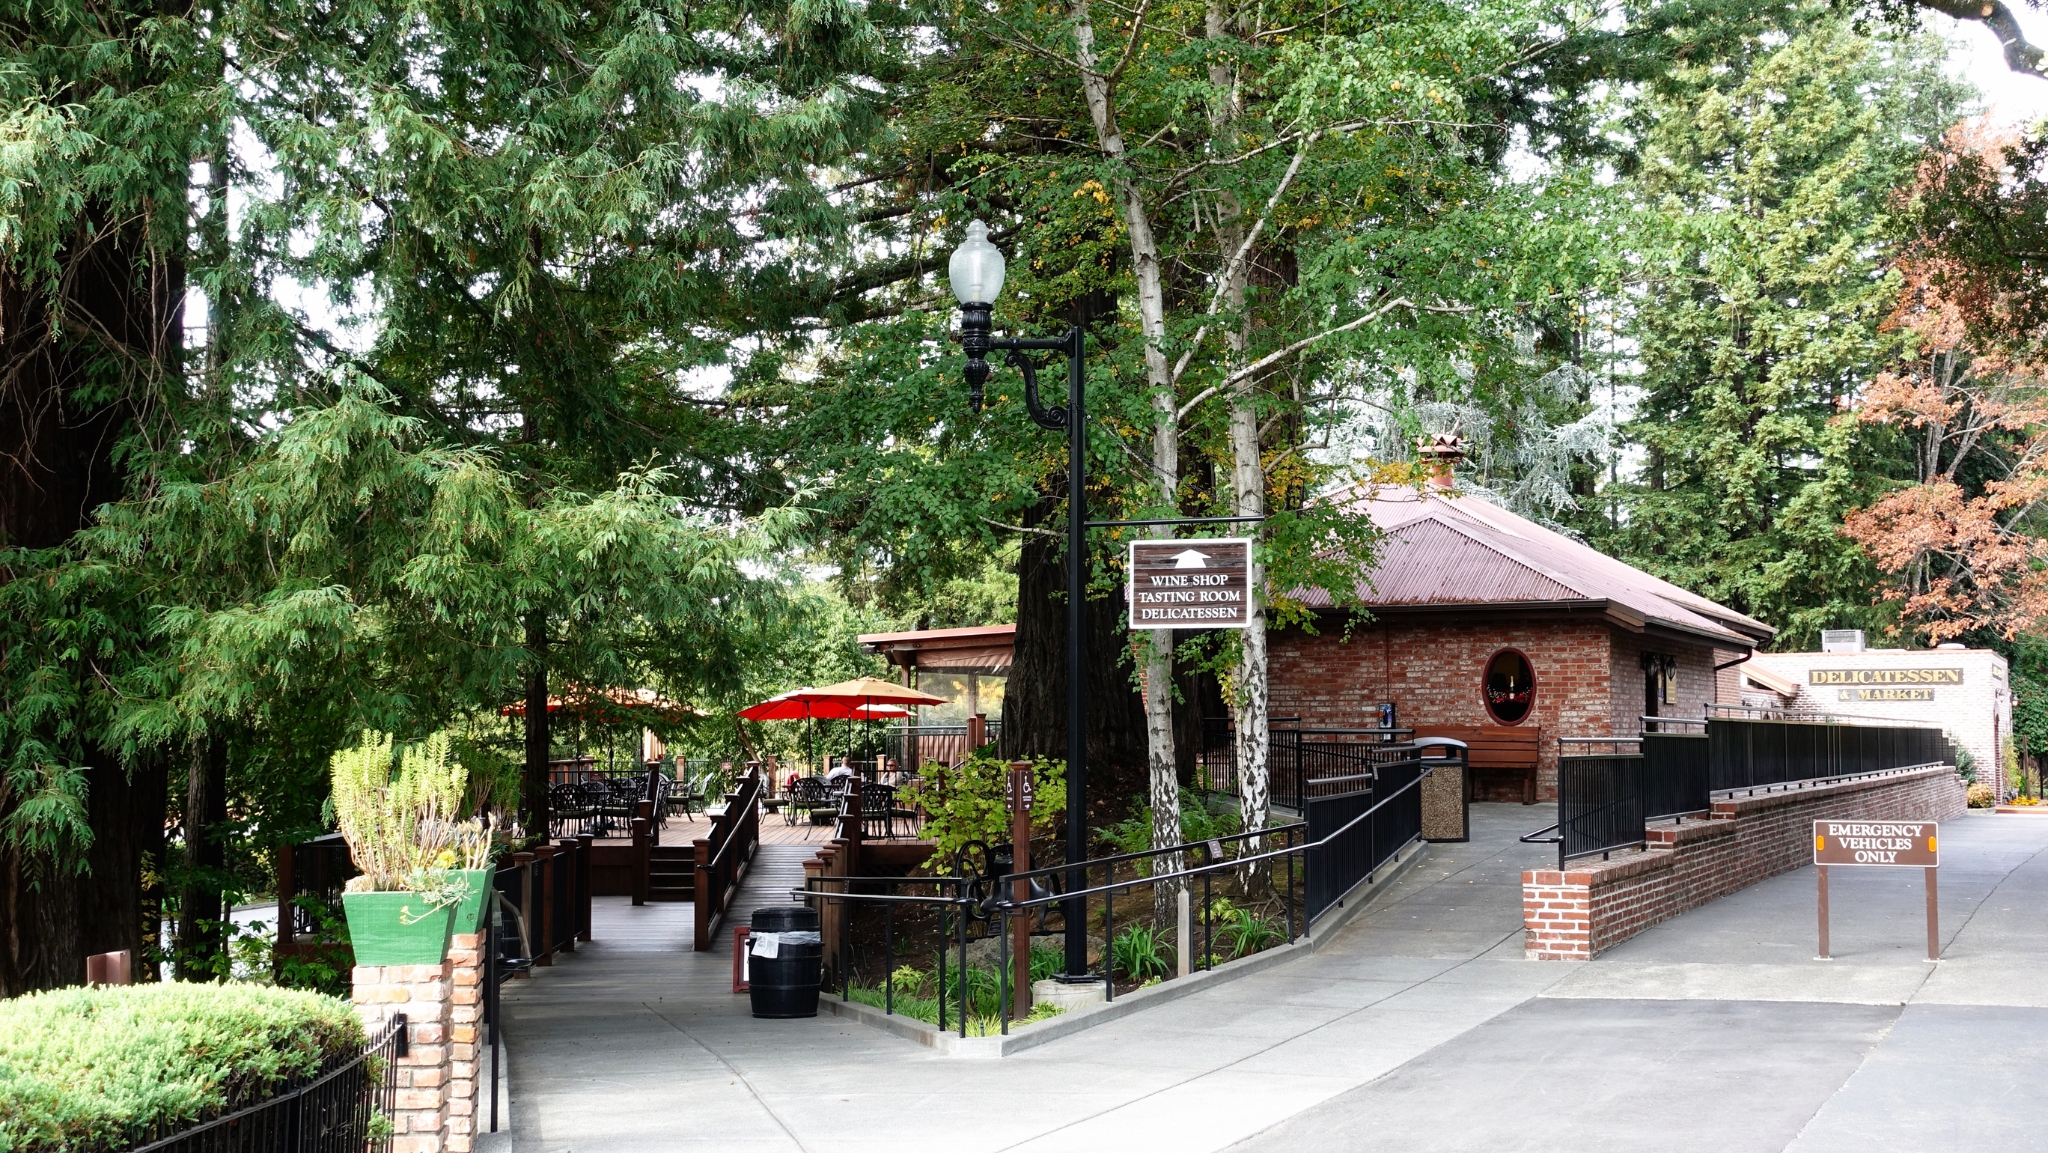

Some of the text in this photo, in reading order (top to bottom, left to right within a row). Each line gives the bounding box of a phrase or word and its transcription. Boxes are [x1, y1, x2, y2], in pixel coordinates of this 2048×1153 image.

[1151, 574, 1229, 586] WINE SHOP
[1139, 590, 1240, 603] TASTING ROOM
[1141, 607, 1238, 619] DELICATESSEN
[1811, 669, 1960, 684] DELICATESSEN
[1839, 689, 1932, 700] & MARKET
[1828, 824, 1923, 837] EMERGENCY
[1838, 837, 1912, 850] VEHICLES
[1855, 851, 1897, 863] ONLY
